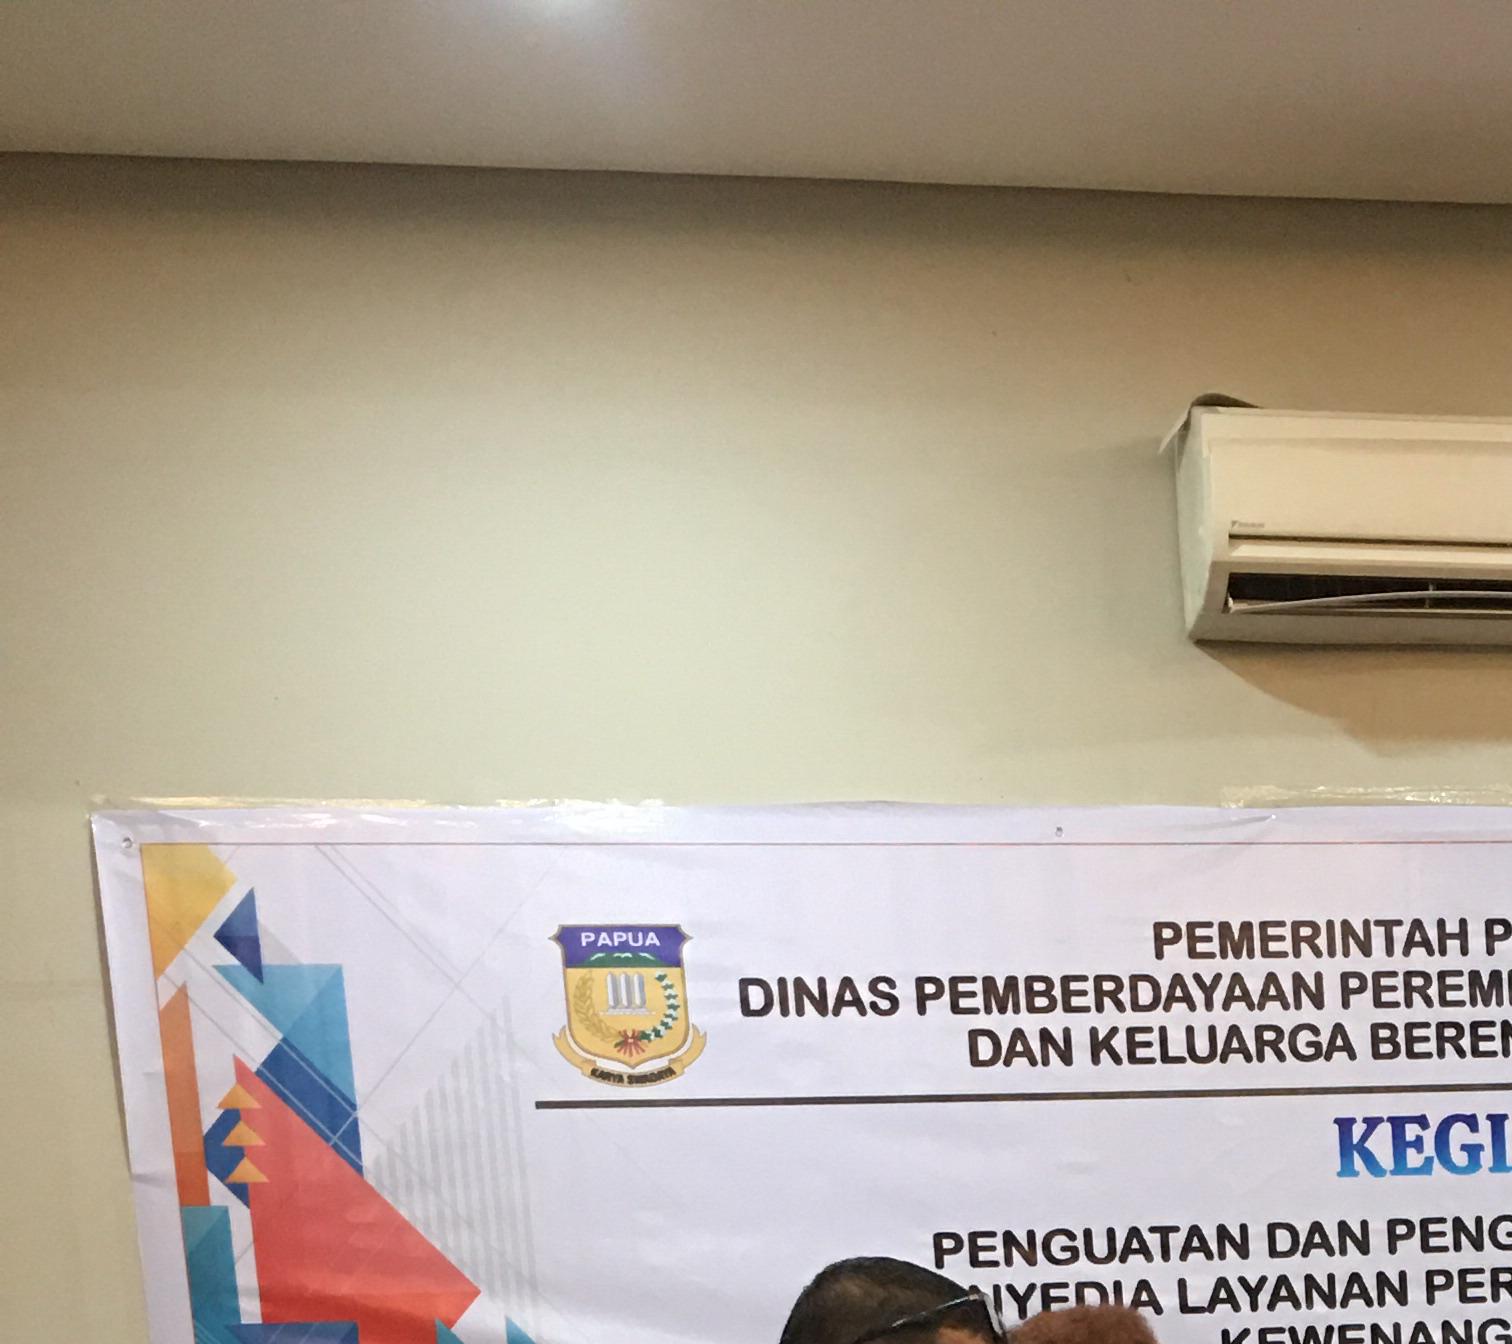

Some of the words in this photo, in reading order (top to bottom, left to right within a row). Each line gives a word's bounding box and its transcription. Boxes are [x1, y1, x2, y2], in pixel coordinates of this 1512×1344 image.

[581, 931, 660, 947] PAPUA
[1153, 918, 1470, 961] PEMERINTAH
[738, 975, 900, 1018] DINAS
[914, 971, 1325, 1017] PEMBERDAYAAN
[967, 1026, 1074, 1068] DAN
[1089, 1022, 1358, 1066] KELUARGA
[932, 1222, 1250, 1270] PENGUATAN
[1266, 1218, 1371, 1259] DAN
[968, 1278, 1164, 1321] NYEDIA
[1177, 1269, 1409, 1315] LAYANAN
